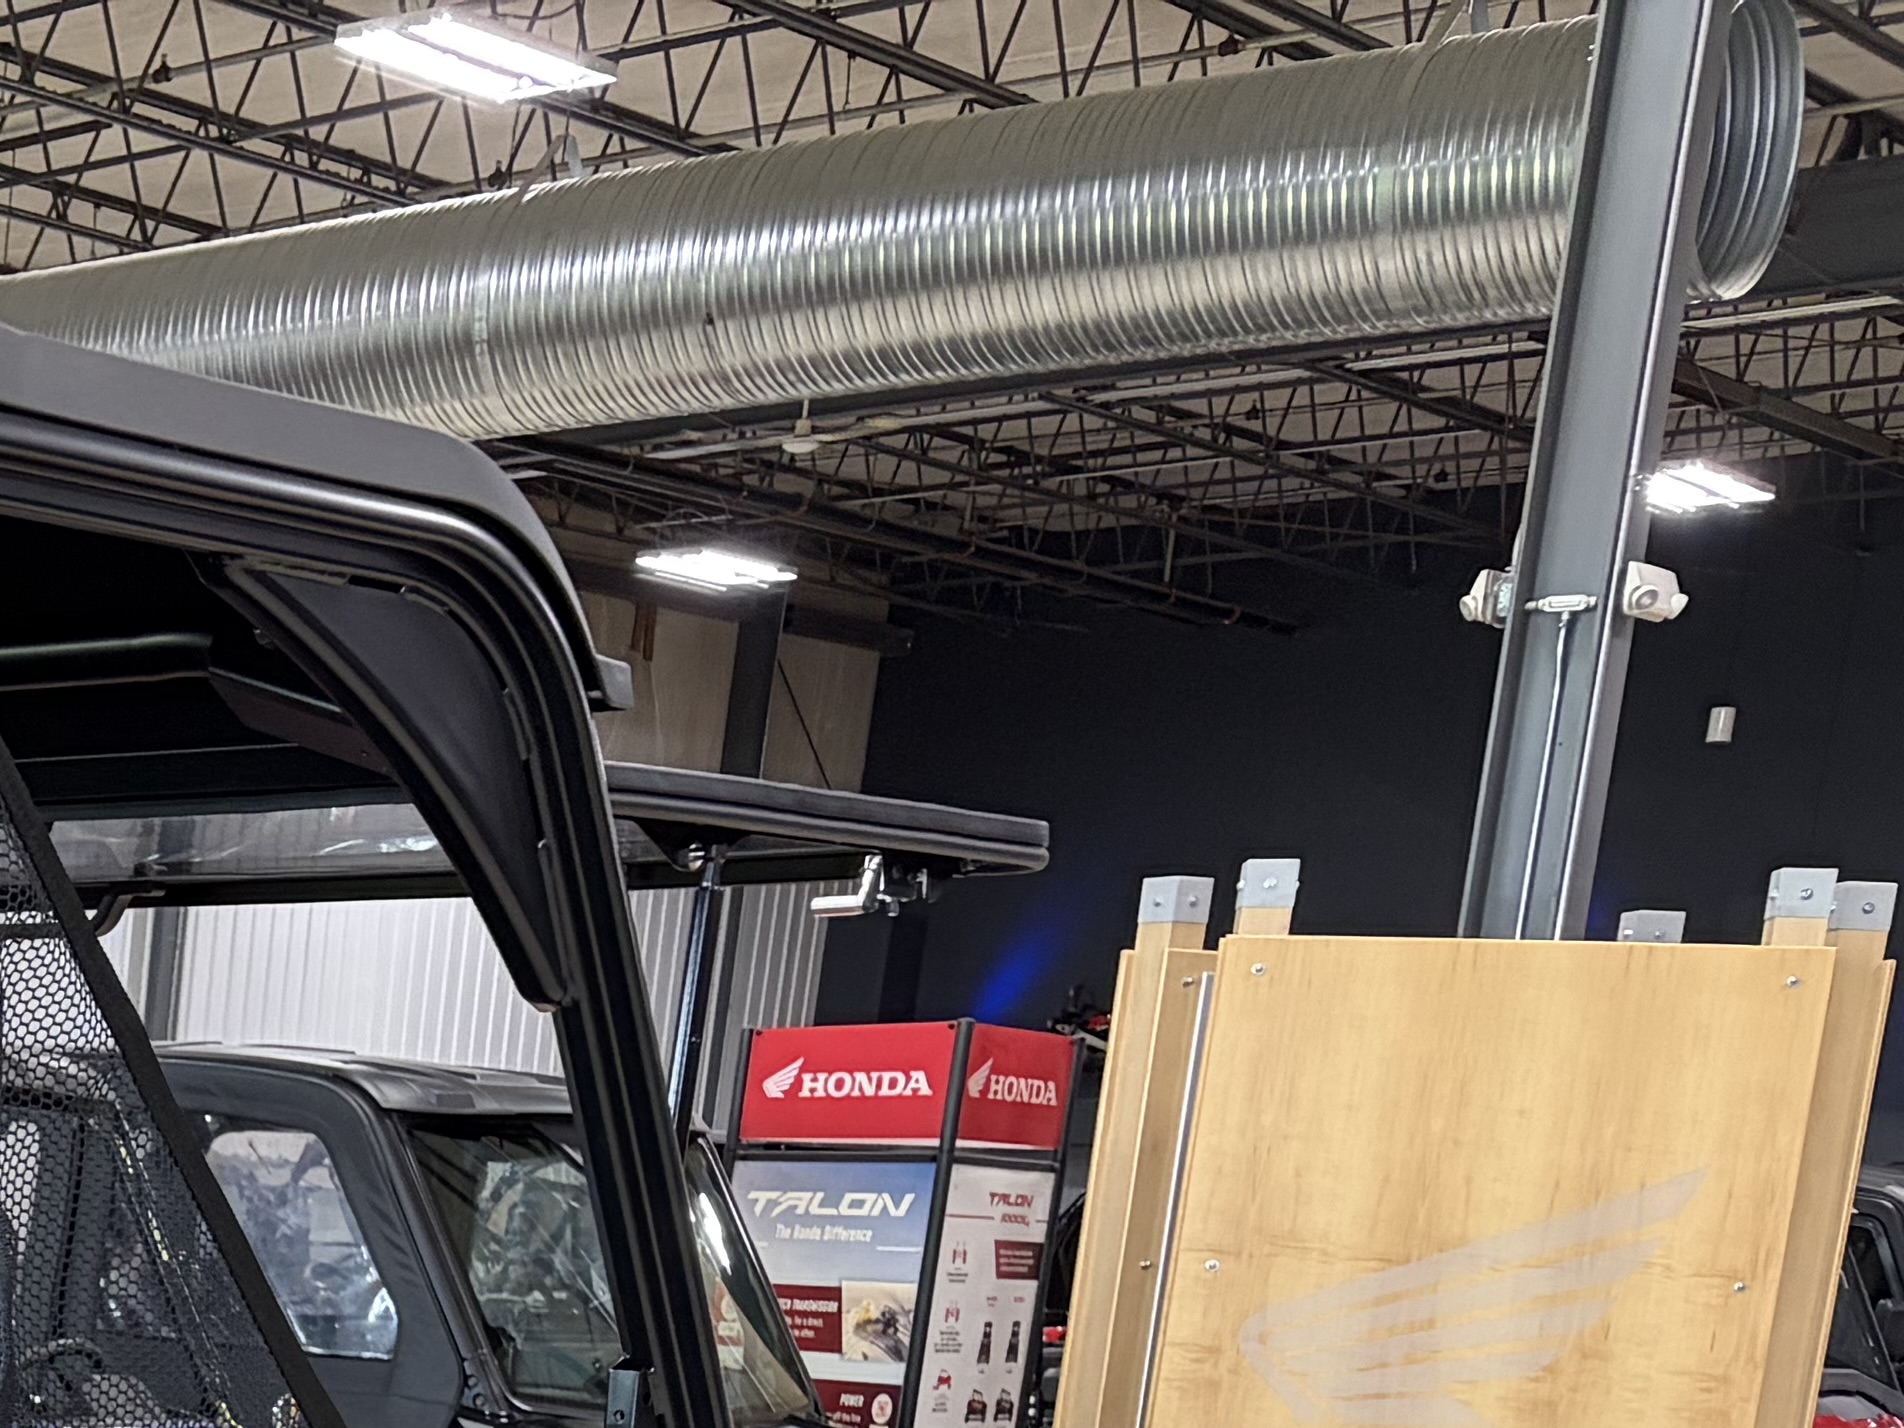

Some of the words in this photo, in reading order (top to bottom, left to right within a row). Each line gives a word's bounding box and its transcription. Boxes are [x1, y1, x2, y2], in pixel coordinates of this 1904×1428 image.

[799, 1070, 932, 1098] HONDA
[989, 1074, 1058, 1106] HONDA
[747, 1190, 916, 1218] TALON
[989, 1191, 1034, 1209] TALON
[775, 1223, 792, 1240] The
[793, 1224, 822, 1241] Honda
[823, 1224, 873, 1243] Difference
